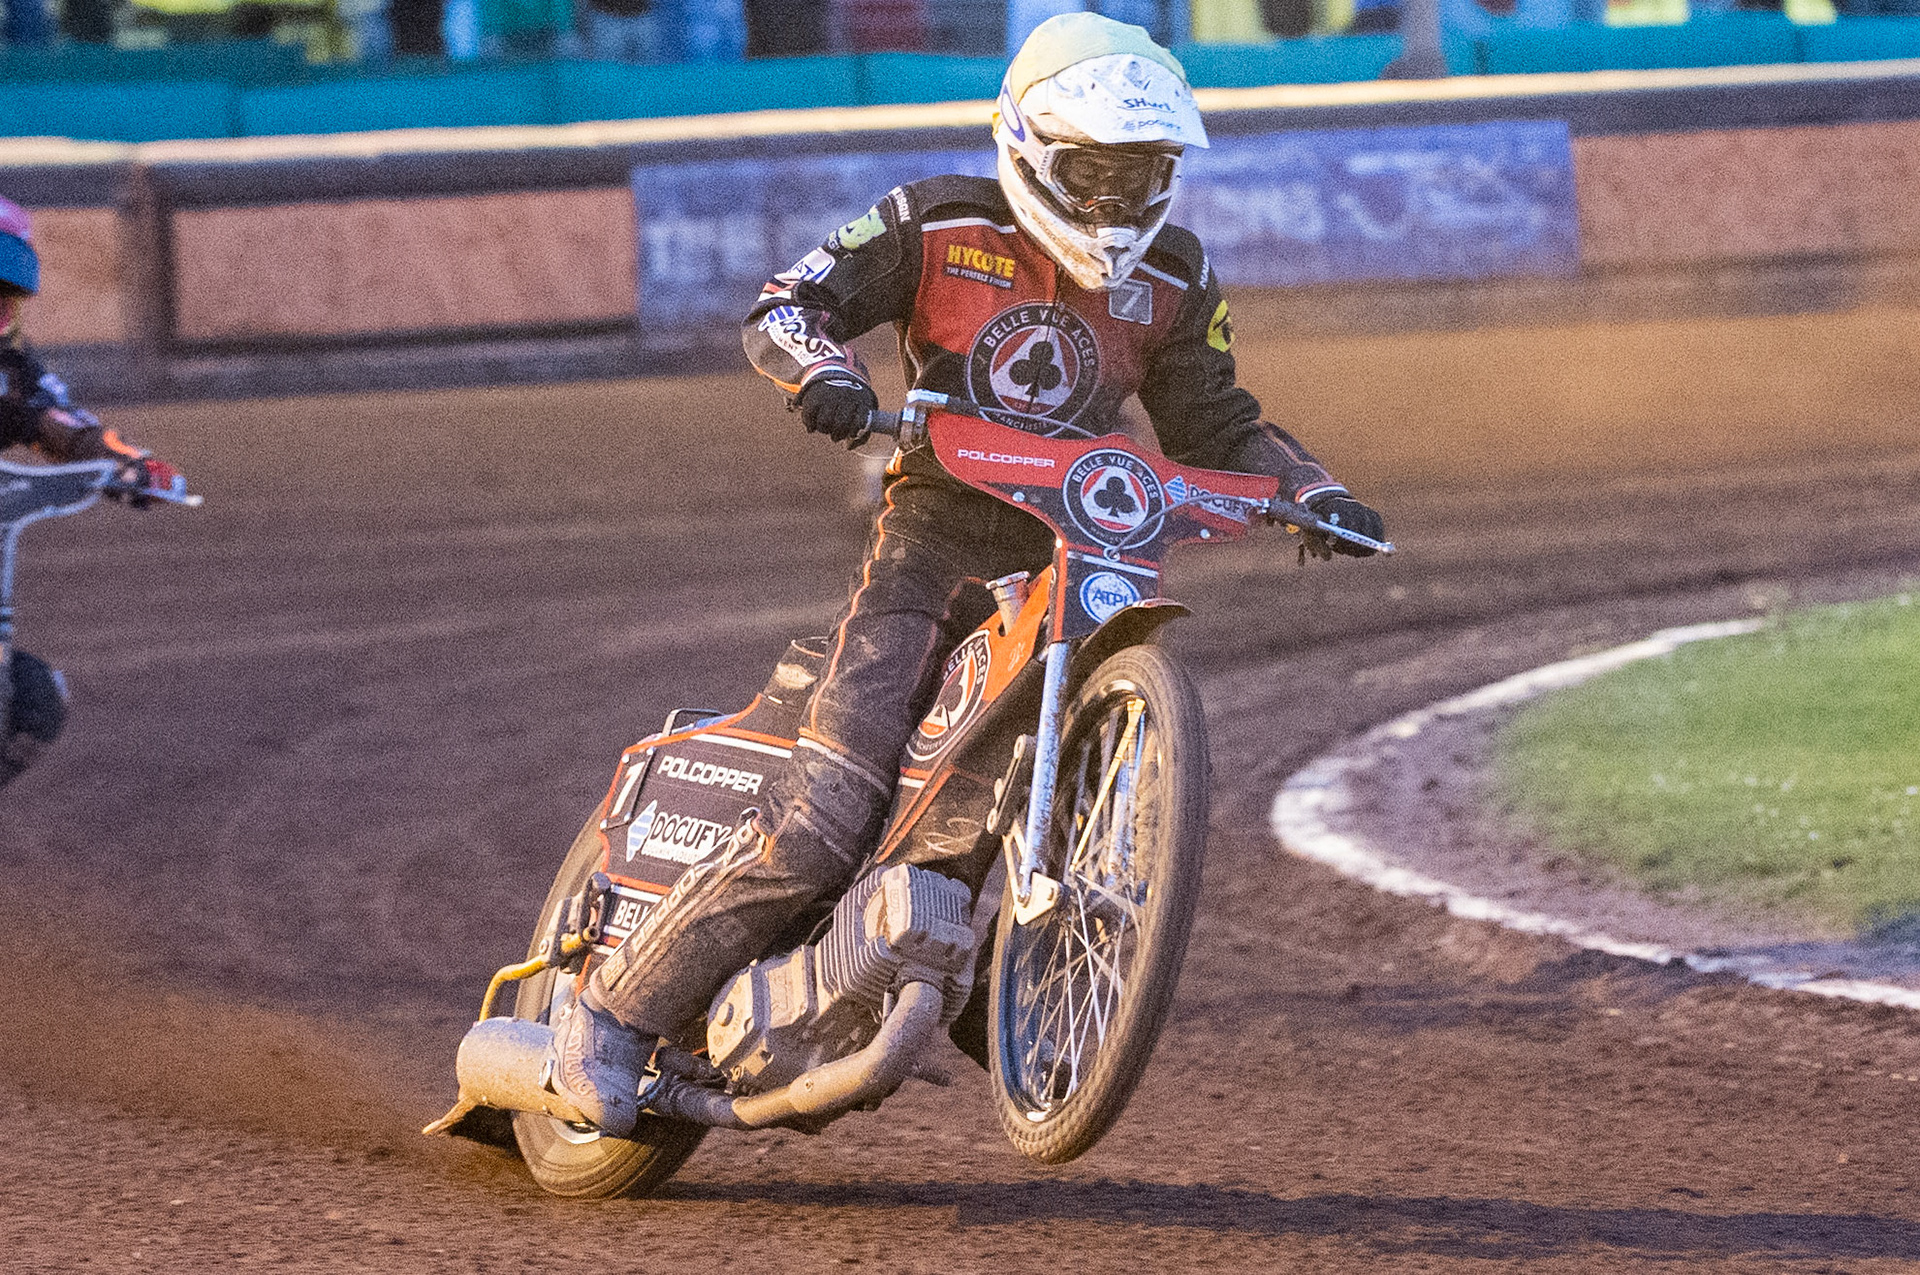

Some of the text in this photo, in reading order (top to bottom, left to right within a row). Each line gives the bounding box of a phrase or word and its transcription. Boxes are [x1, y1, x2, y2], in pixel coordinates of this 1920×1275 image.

[946, 266, 959, 276] THE
[960, 269, 989, 283] PERFECT
[947, 244, 1016, 278] HYCOTE
[983, 309, 1095, 367] BELLE VUE ACES
[957, 448, 1055, 468] POLCOPPER
[1072, 455, 1158, 499] BELLE VUE ACES
[610, 761, 646, 818] 1
[657, 755, 764, 795] POLCOPPER
[650, 814, 731, 850] DOCUFY
